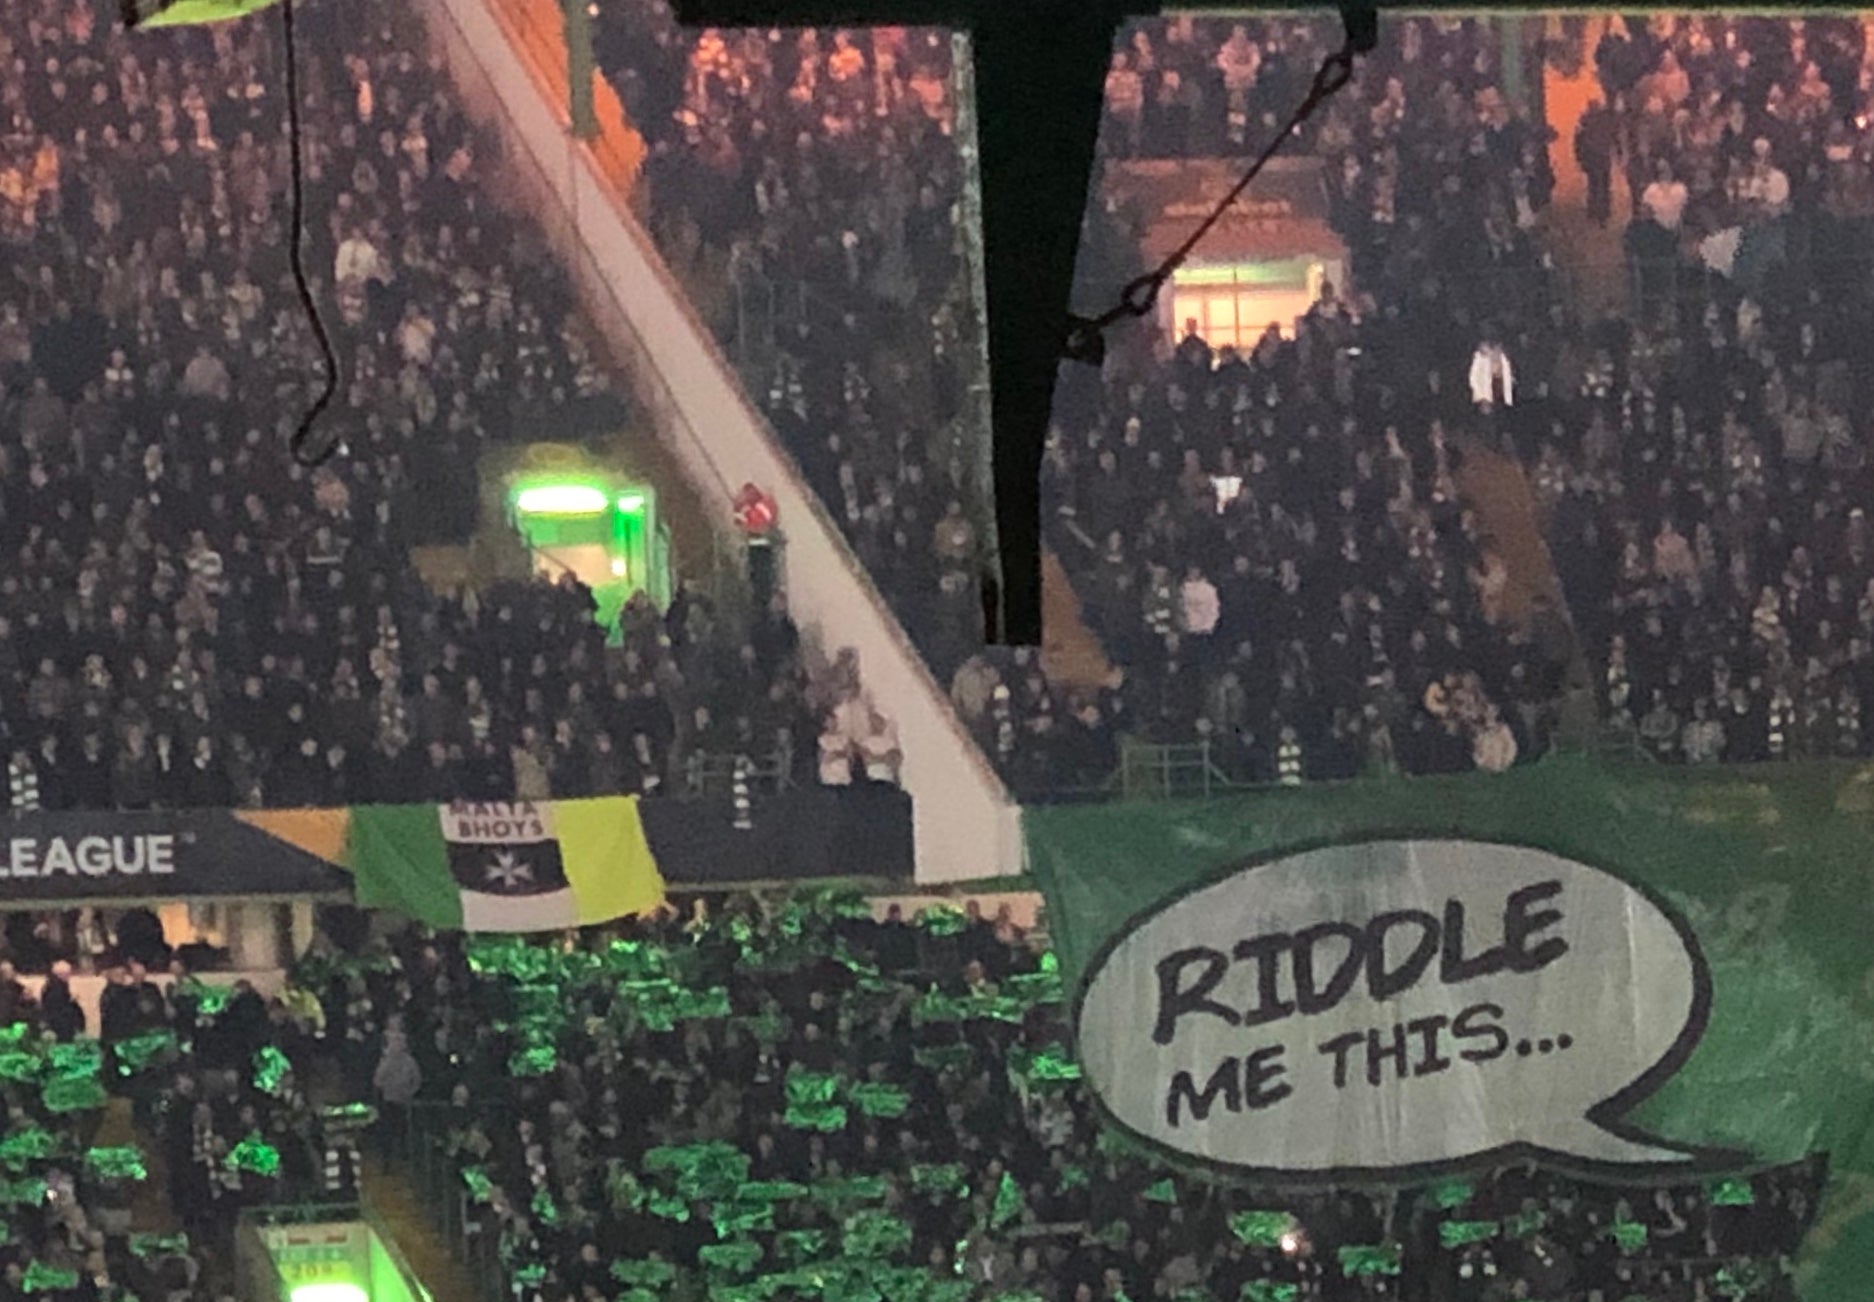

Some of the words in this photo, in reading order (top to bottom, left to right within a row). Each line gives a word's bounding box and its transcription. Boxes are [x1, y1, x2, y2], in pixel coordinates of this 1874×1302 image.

[0, 834, 176, 877] EAGUE
[457, 820, 544, 838] BHOYS
[1152, 879, 1570, 1045] RIDDLE
[1166, 1044, 1293, 1127] ME
[1317, 1003, 1573, 1089] THIS...
